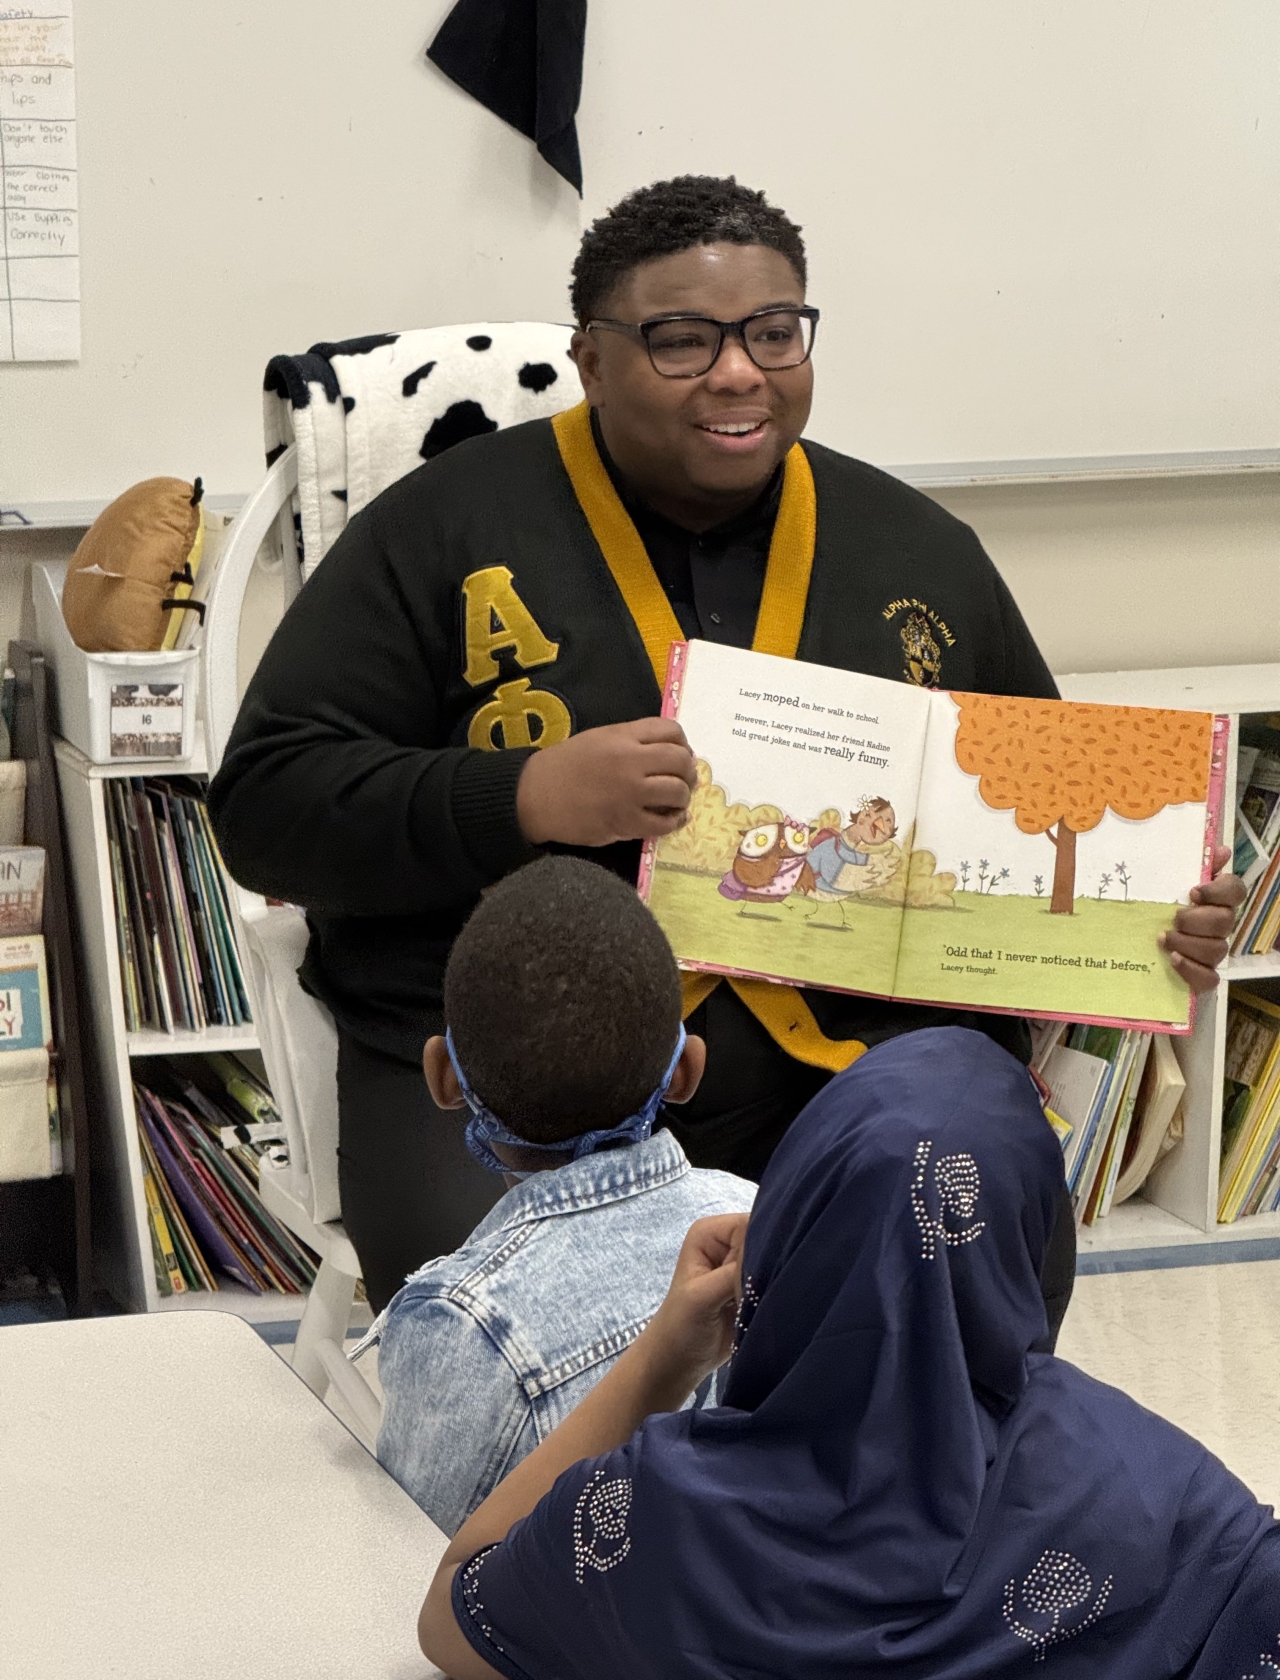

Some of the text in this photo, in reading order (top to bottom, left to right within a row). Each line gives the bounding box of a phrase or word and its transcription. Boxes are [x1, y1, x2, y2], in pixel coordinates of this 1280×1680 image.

[31, 73, 52, 85] and
[12, 91, 36, 108] lips
[39, 123, 68, 134] touch
[43, 134, 63, 144] else
[882, 598, 911, 621] ALPHA
[927, 610, 957, 647] ALPHA
[739, 688, 880, 725] Lacey moped on her walk to school.
[734, 712, 891, 752] However, Lacey realized her friend Nadine
[732, 728, 890, 769] told great jokes and was really funny.
[970, 947, 993, 959] that
[997, 950, 1002, 960] I
[1005, 952, 1038, 963] never
[1041, 955, 1082, 967] noticed
[1084, 957, 1107, 969] that
[941, 963, 998, 976] Lacey thought.
